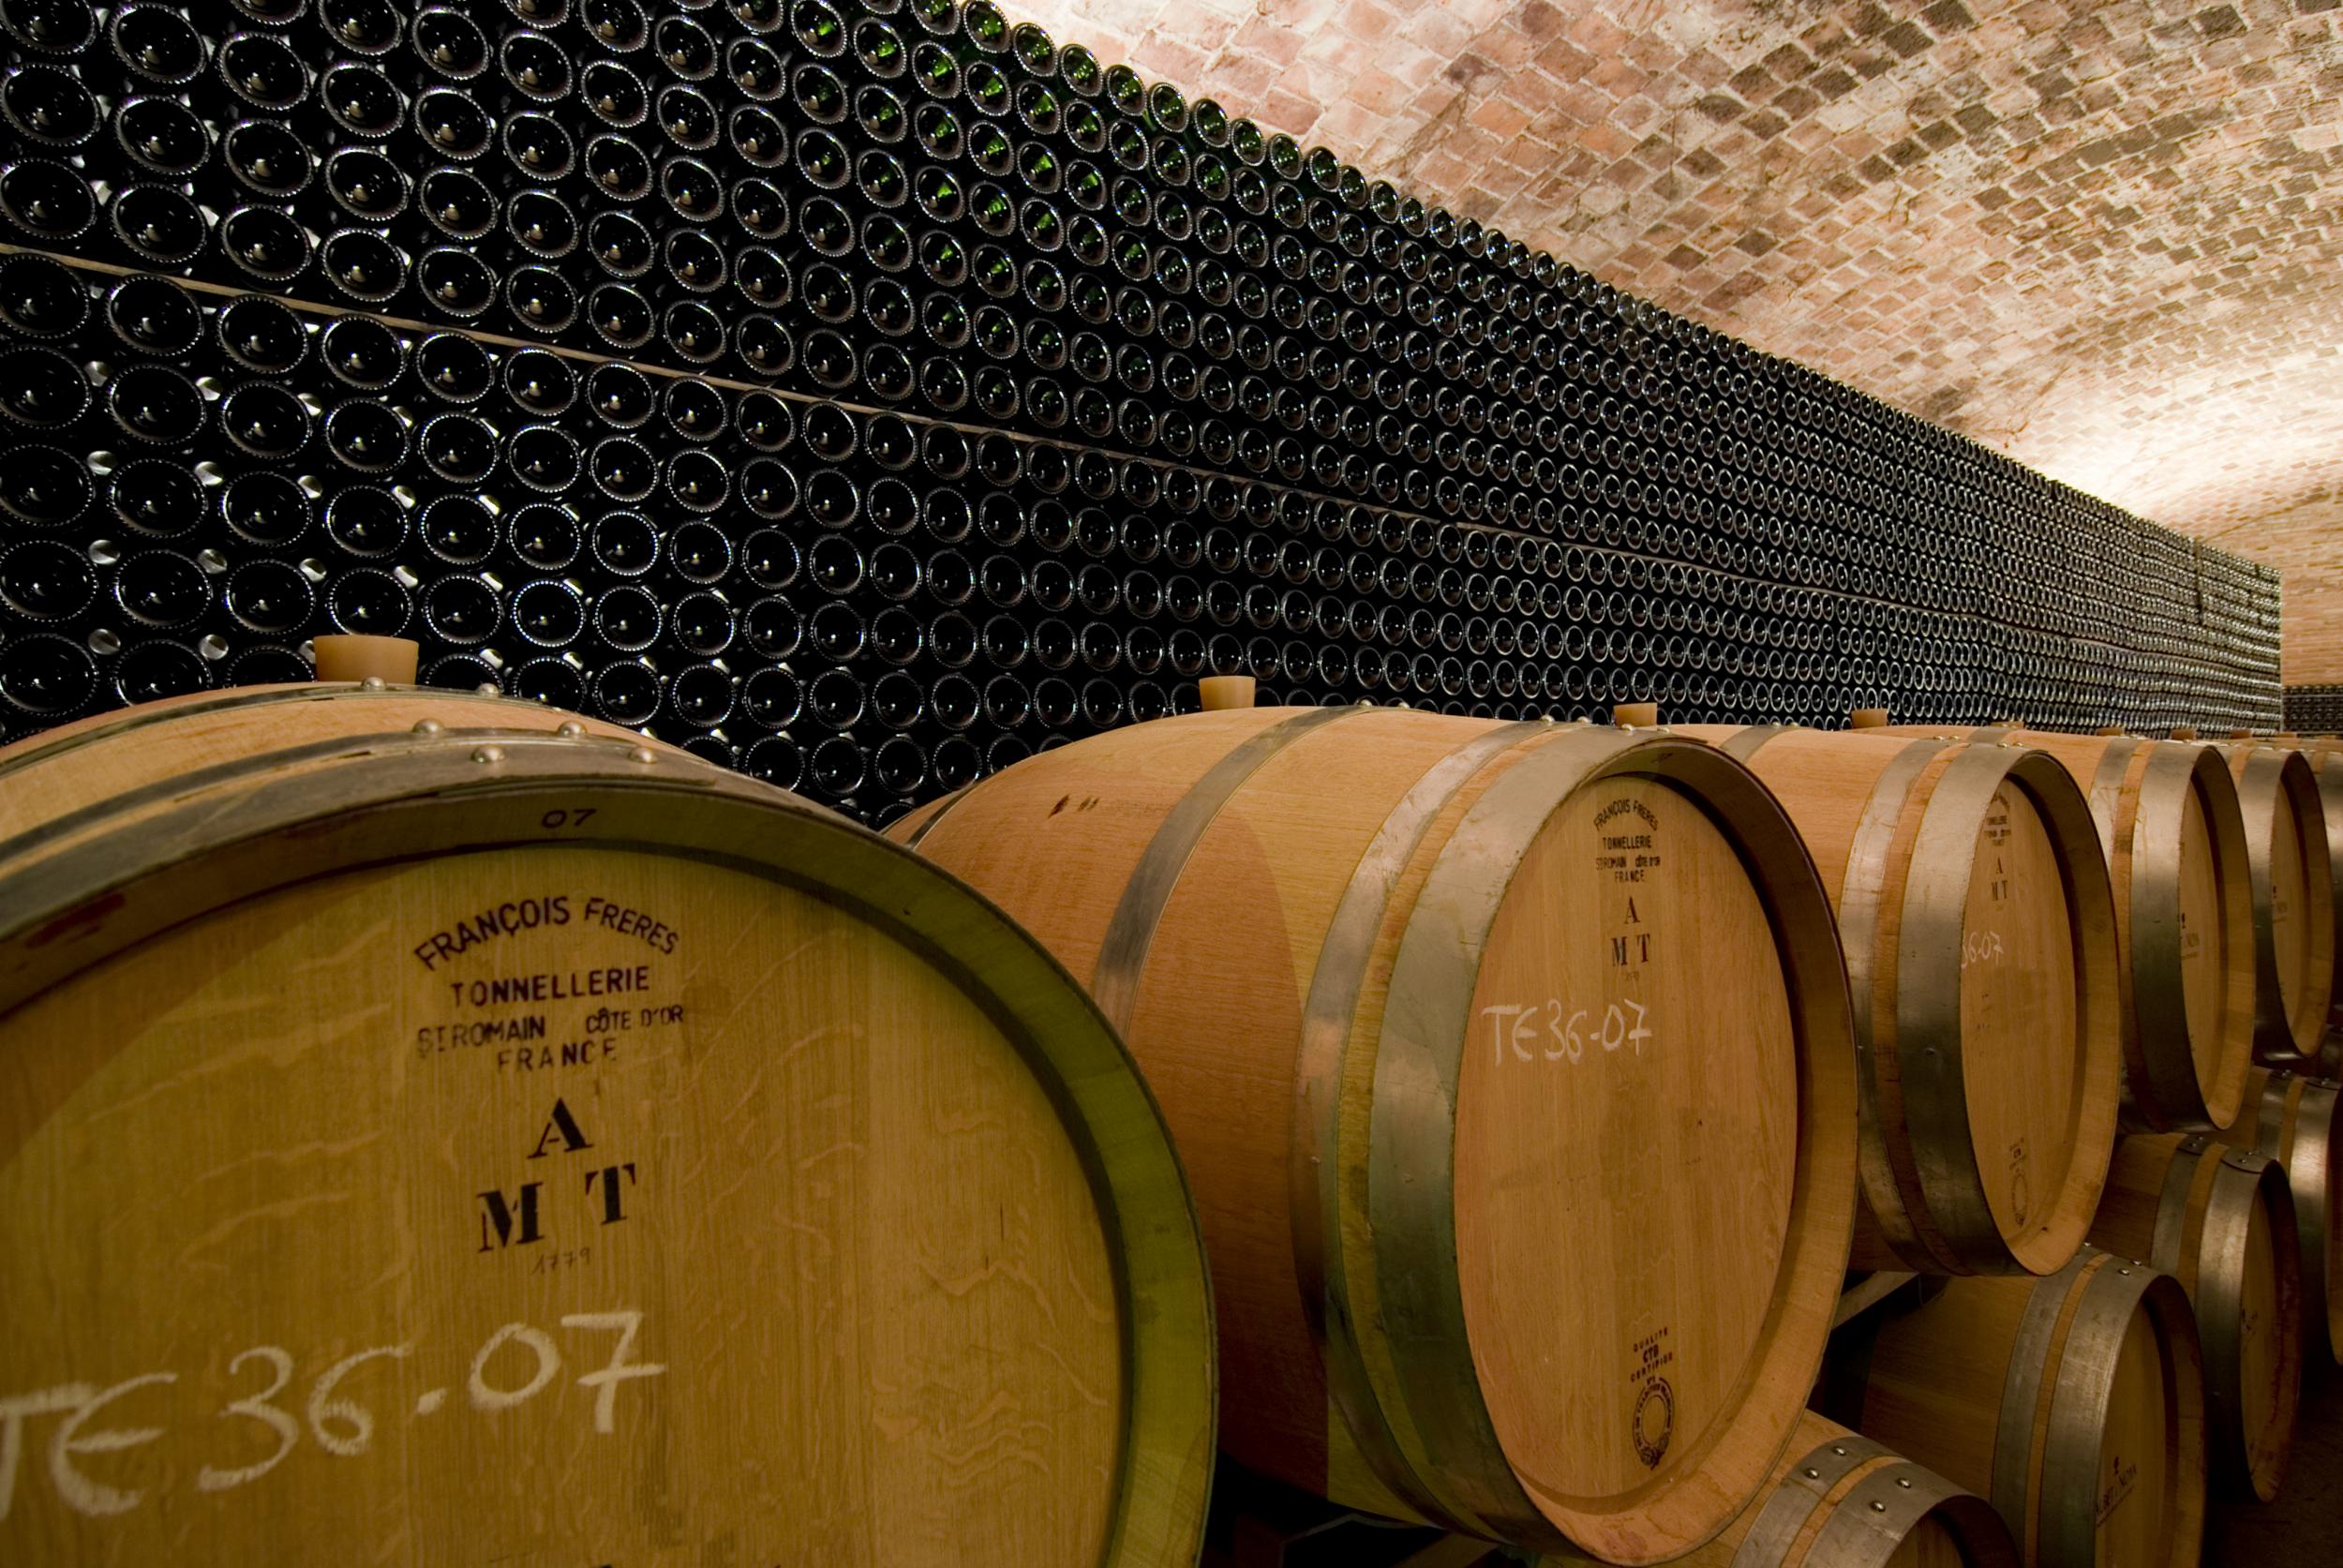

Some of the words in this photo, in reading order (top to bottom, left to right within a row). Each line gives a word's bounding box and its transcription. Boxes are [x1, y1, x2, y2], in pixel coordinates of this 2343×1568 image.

[542, 809, 596, 829] 07
[1594, 799, 1631, 831] FRANÇOIS
[1634, 800, 1659, 831] FRERES
[1603, 835, 1652, 851] TONNELLERIE
[1615, 870, 1645, 883] FRANCE
[1624, 896, 1640, 925] A
[414, 896, 571, 971] FRANÇOIS
[585, 897, 679, 955] FRERES
[1612, 935, 1628, 966] M
[1636, 933, 1650, 963] T
[450, 966, 650, 1008] TONNELLERIE
[586, 1008, 632, 1035] CÔTE
[641, 1004, 684, 1027] D'OR
[498, 1038, 618, 1074] FRANCE
[527, 1098, 594, 1159] A
[476, 1181, 545, 1253] M
[585, 1162, 636, 1226] T
